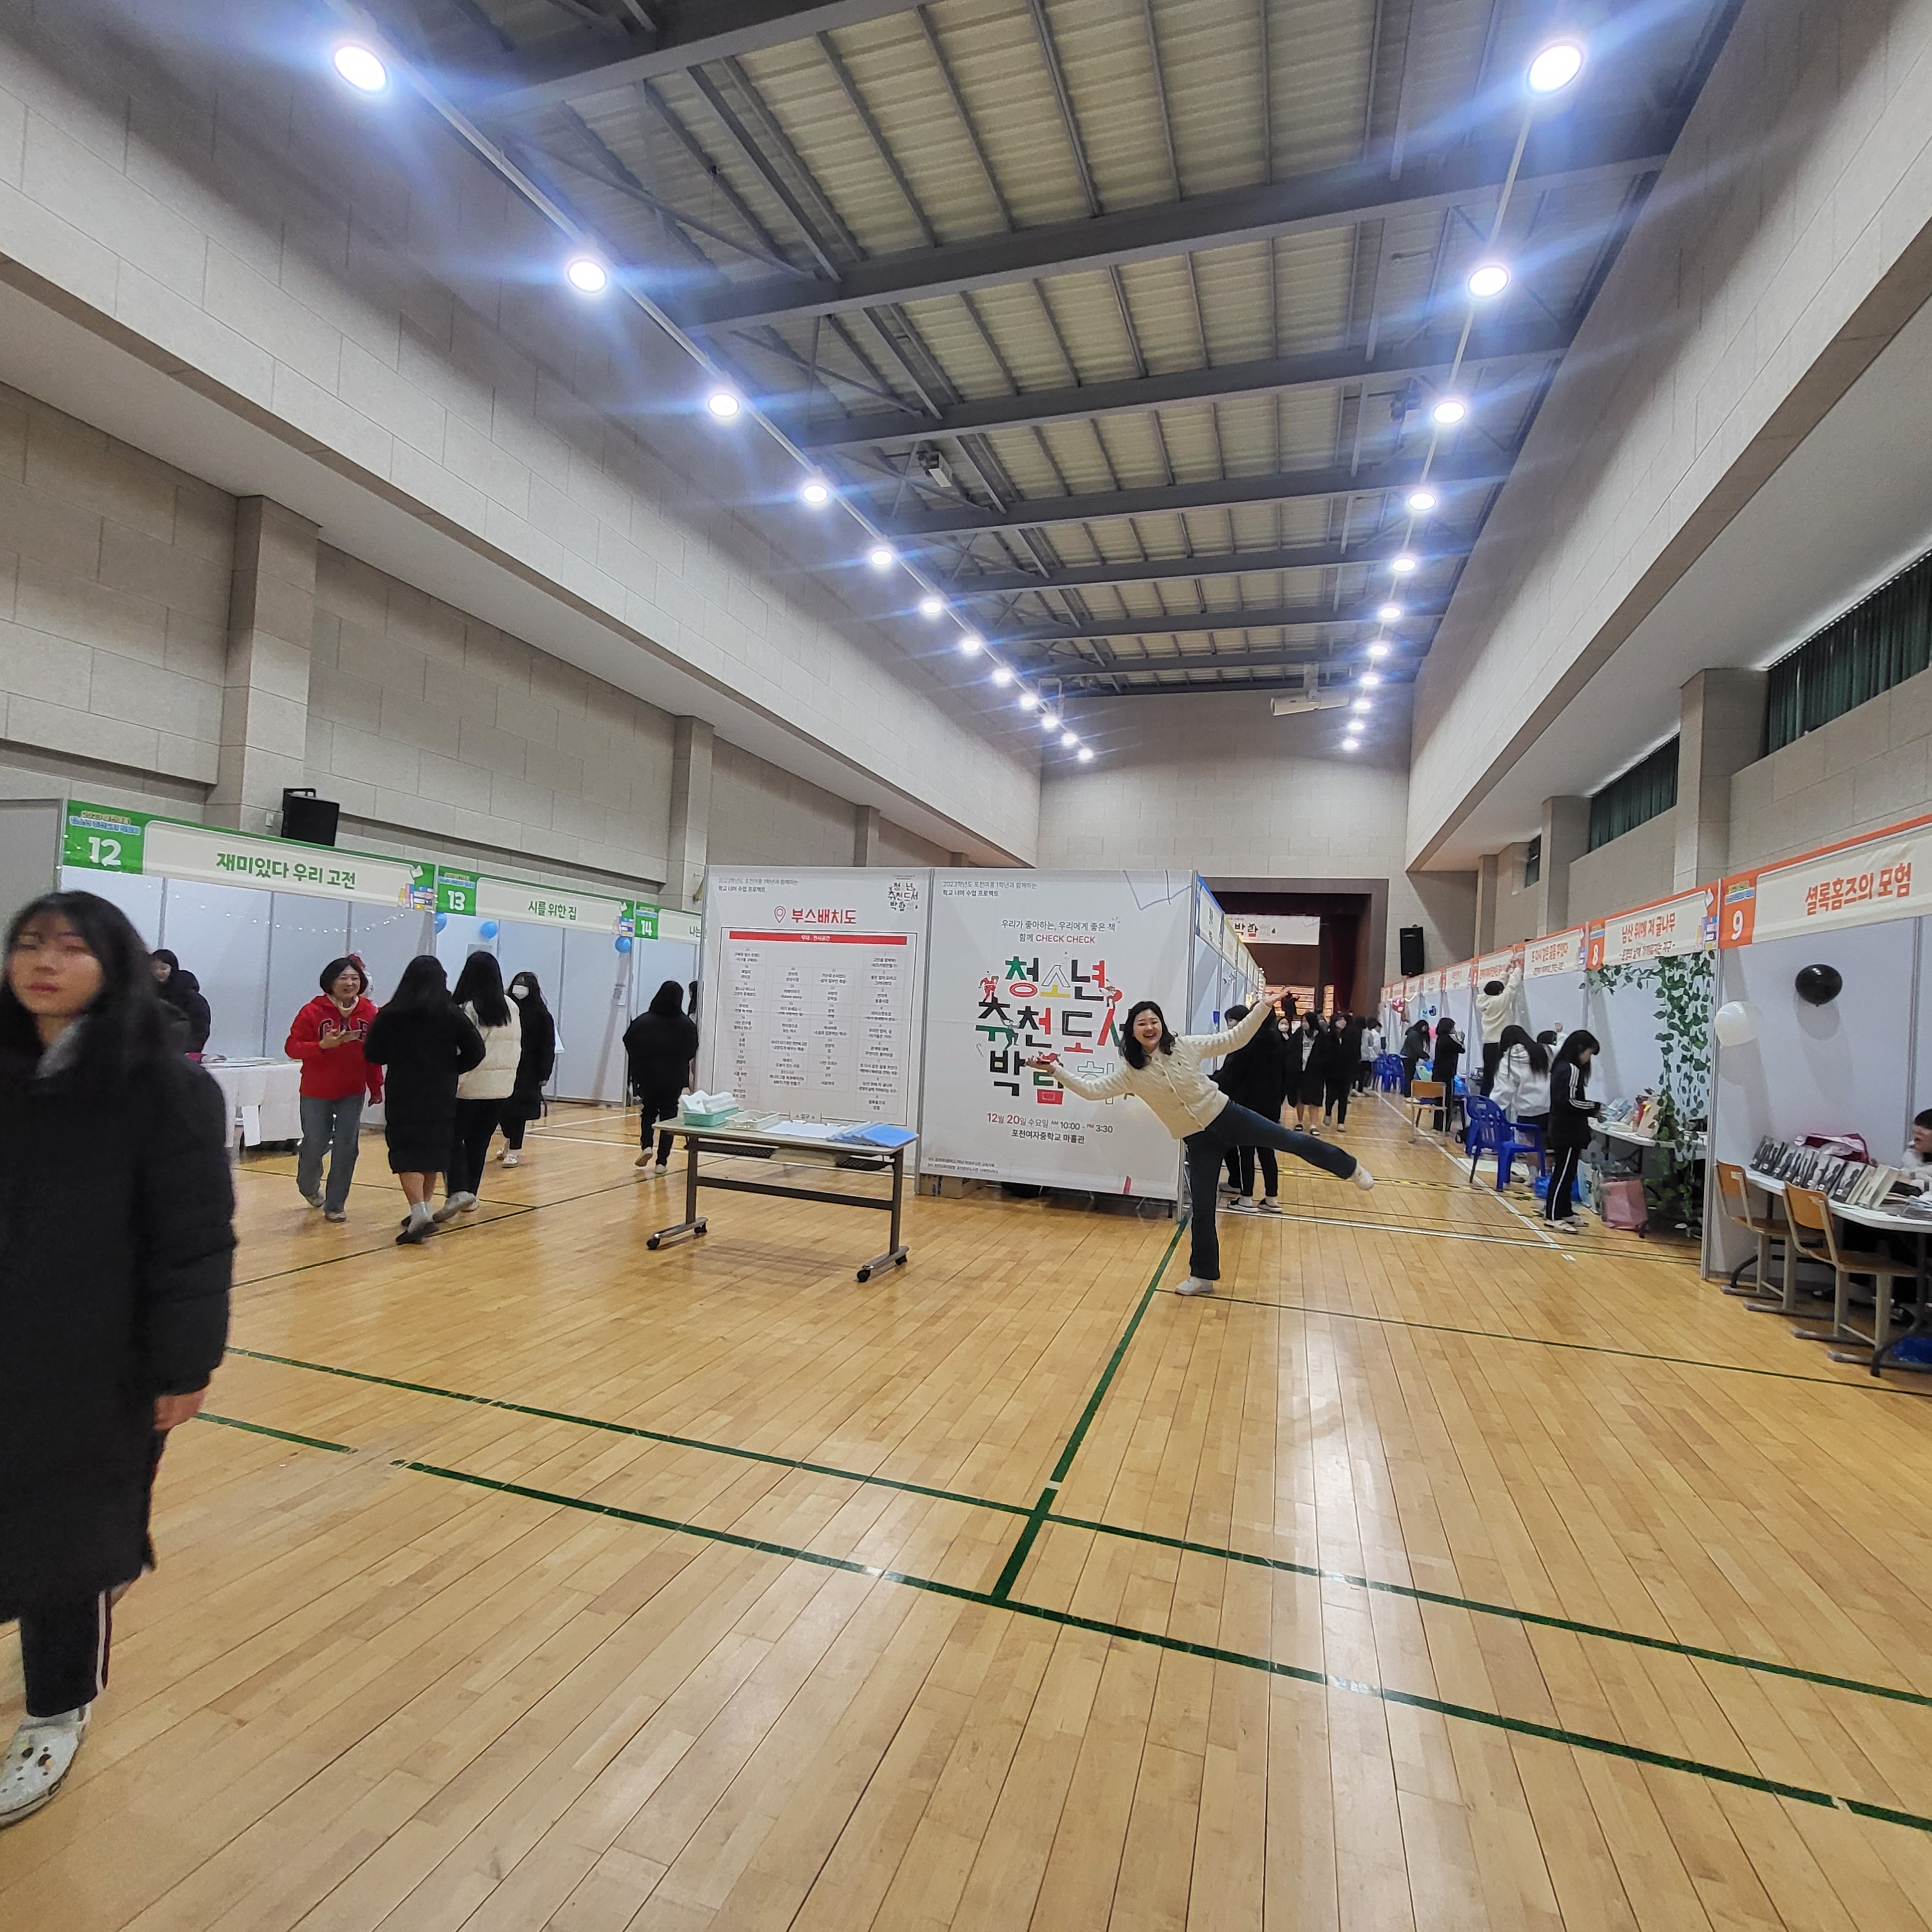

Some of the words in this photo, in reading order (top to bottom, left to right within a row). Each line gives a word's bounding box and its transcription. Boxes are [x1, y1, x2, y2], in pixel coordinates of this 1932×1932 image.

[88, 837, 121, 867] 12
[216, 853, 289, 878] 재미있다
[293, 863, 323, 883] 우리
[327, 869, 355, 890] 고전
[1805, 872, 1874, 916] 셜록홈즈의
[1877, 862, 1912, 898] 모험
[447, 890, 466, 911] 13
[528, 901, 546, 916] 시를
[548, 903, 566, 918] 위한
[568, 906, 577, 920] 집
[792, 909, 857, 924] 부스배치도
[1002, 920, 1023, 929] 우리가
[1025, 920, 1056, 930] 좋아하는,
[1058, 921, 1088, 931] 우리에게
[1091, 922, 1105, 932] 좋은
[1107, 923, 1115, 932] 책
[1731, 910, 1743, 940] 9
[641, 920, 652, 936] 14
[1622, 924, 1633, 944] 남산
[1019, 933, 1033, 941] 함께
[1066, 936, 1096, 944] CHECK
[1592, 944, 1599, 966] 8
[1005, 956, 1105, 1002] 청소년
[987, 1113, 1005, 1124] 12월
[1007, 1115, 1027, 1126] 20일
[1028, 1118, 1049, 1128] 수요일
[1060, 1122, 1080, 1131] 10:00
[1096, 1125, 1113, 1133] 3:30
[1011, 1129, 1061, 1142] 포천여자중학교
